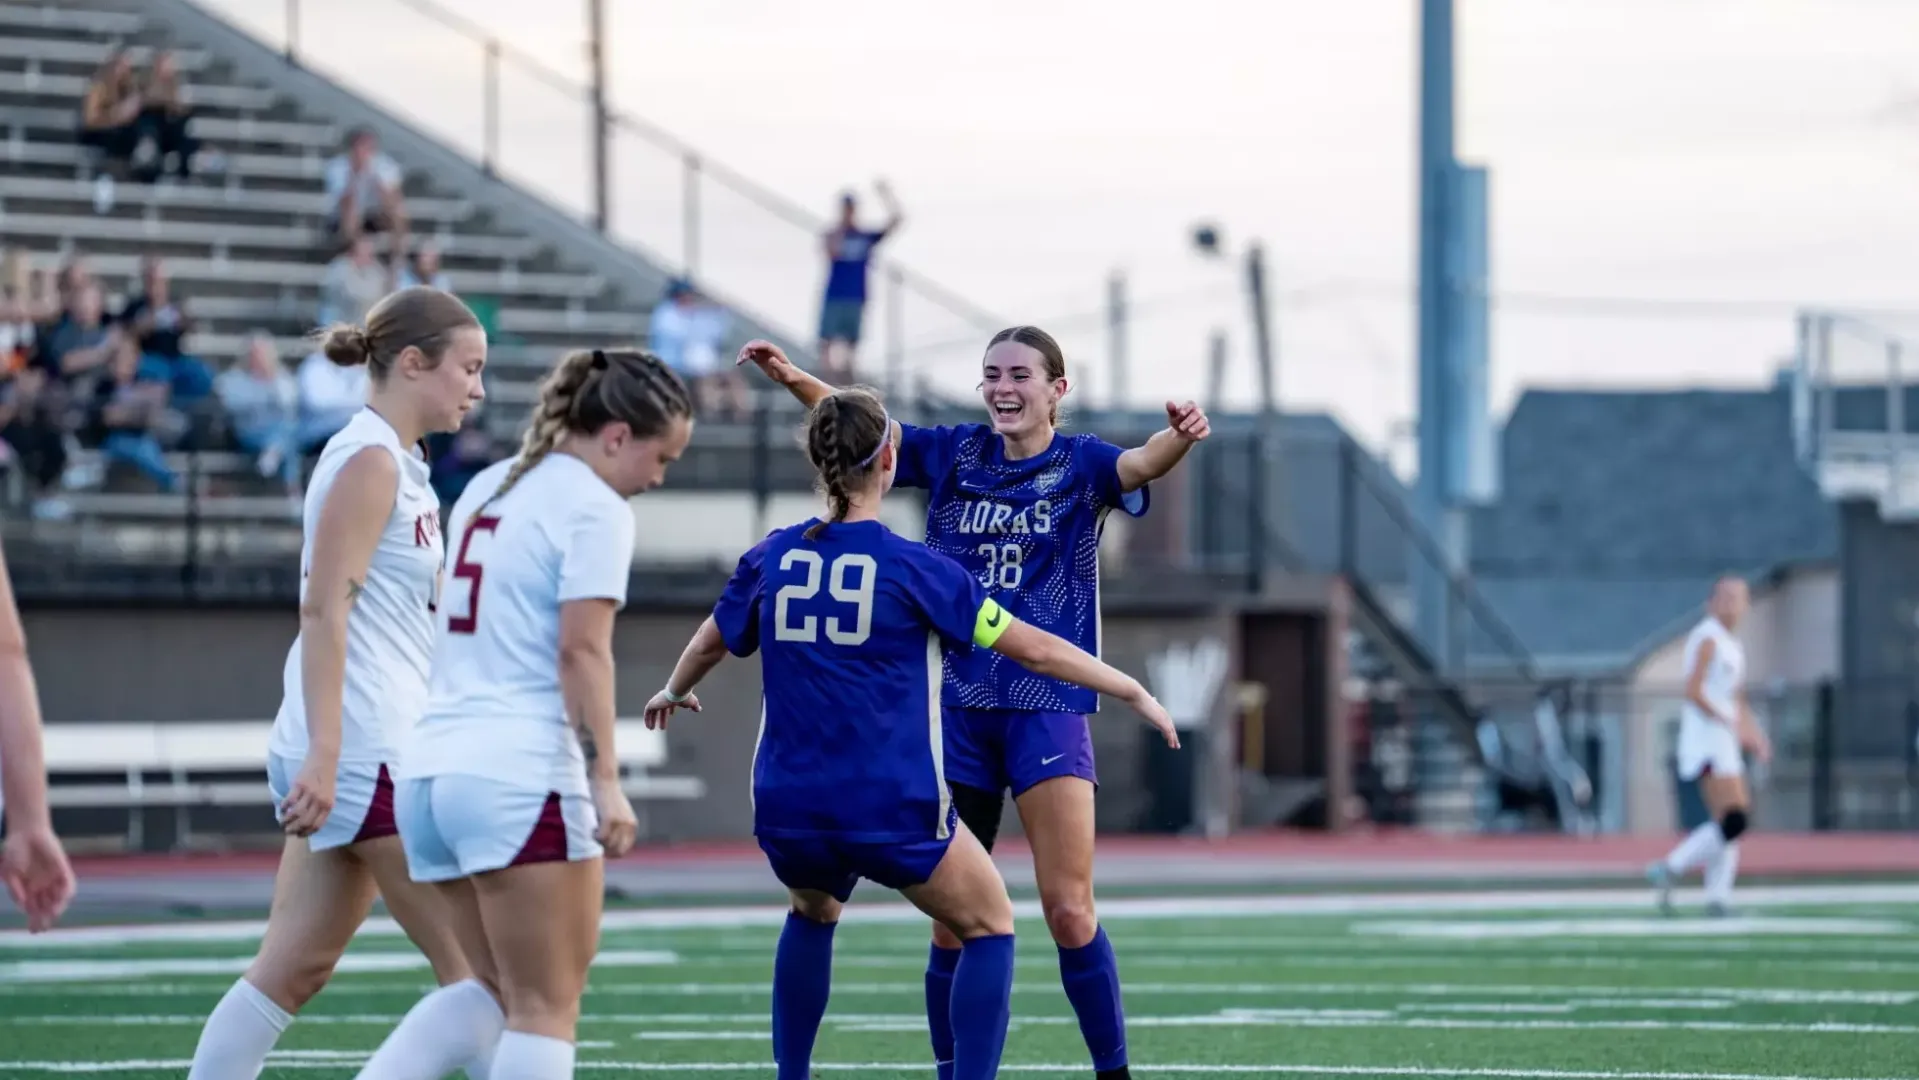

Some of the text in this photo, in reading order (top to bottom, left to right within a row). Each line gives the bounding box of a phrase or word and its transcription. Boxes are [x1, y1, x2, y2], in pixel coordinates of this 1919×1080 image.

[959, 499, 1052, 534] LORAS
[448, 516, 502, 634] 5
[775, 550, 877, 645] 29
[978, 543, 1023, 588] 38
